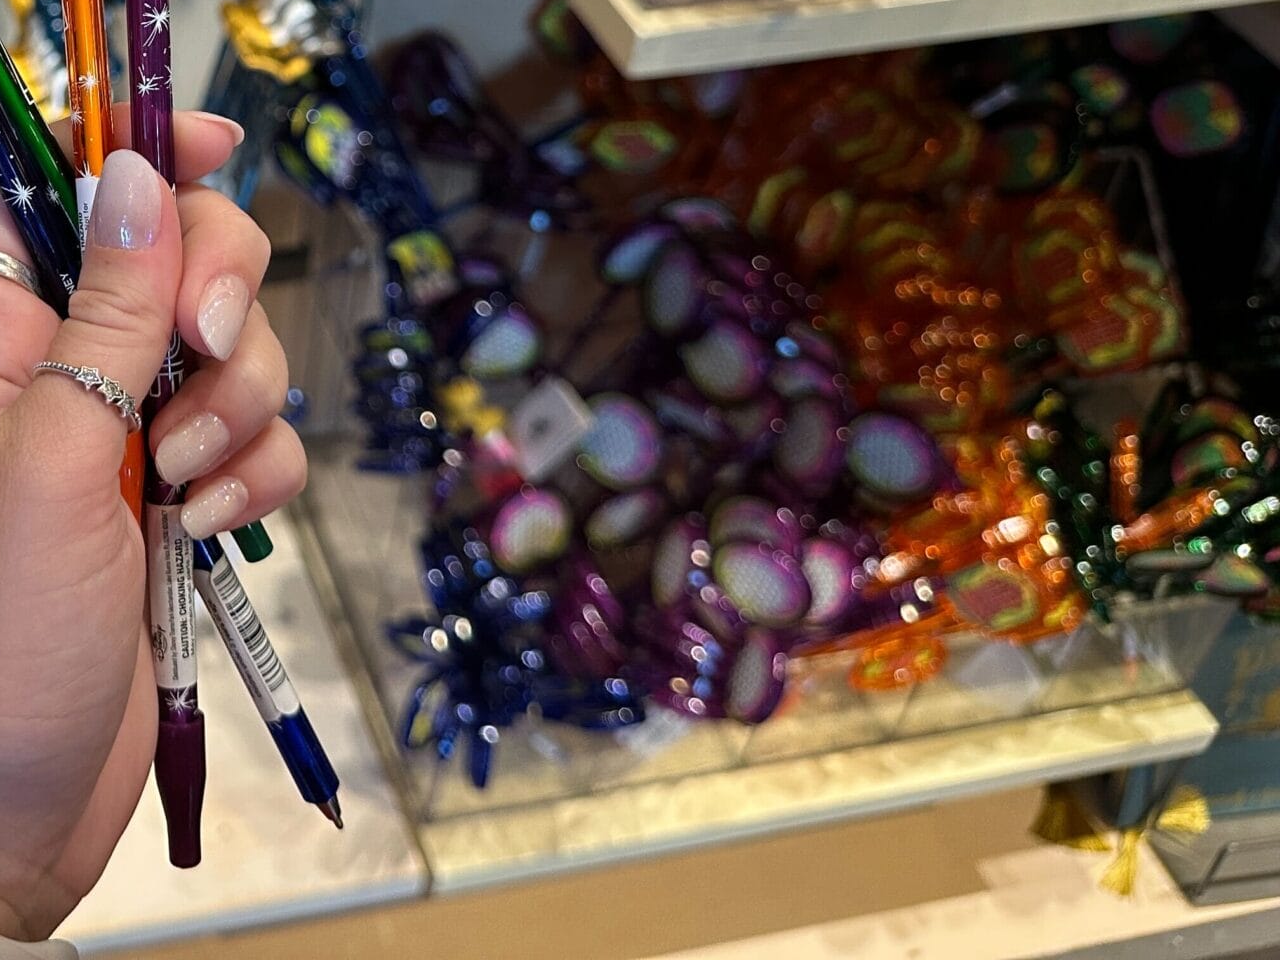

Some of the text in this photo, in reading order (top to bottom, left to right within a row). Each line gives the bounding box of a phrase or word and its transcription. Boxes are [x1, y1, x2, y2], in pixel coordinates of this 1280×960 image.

[175, 538, 190, 658] CAUTION: CHOKING HAZARD
